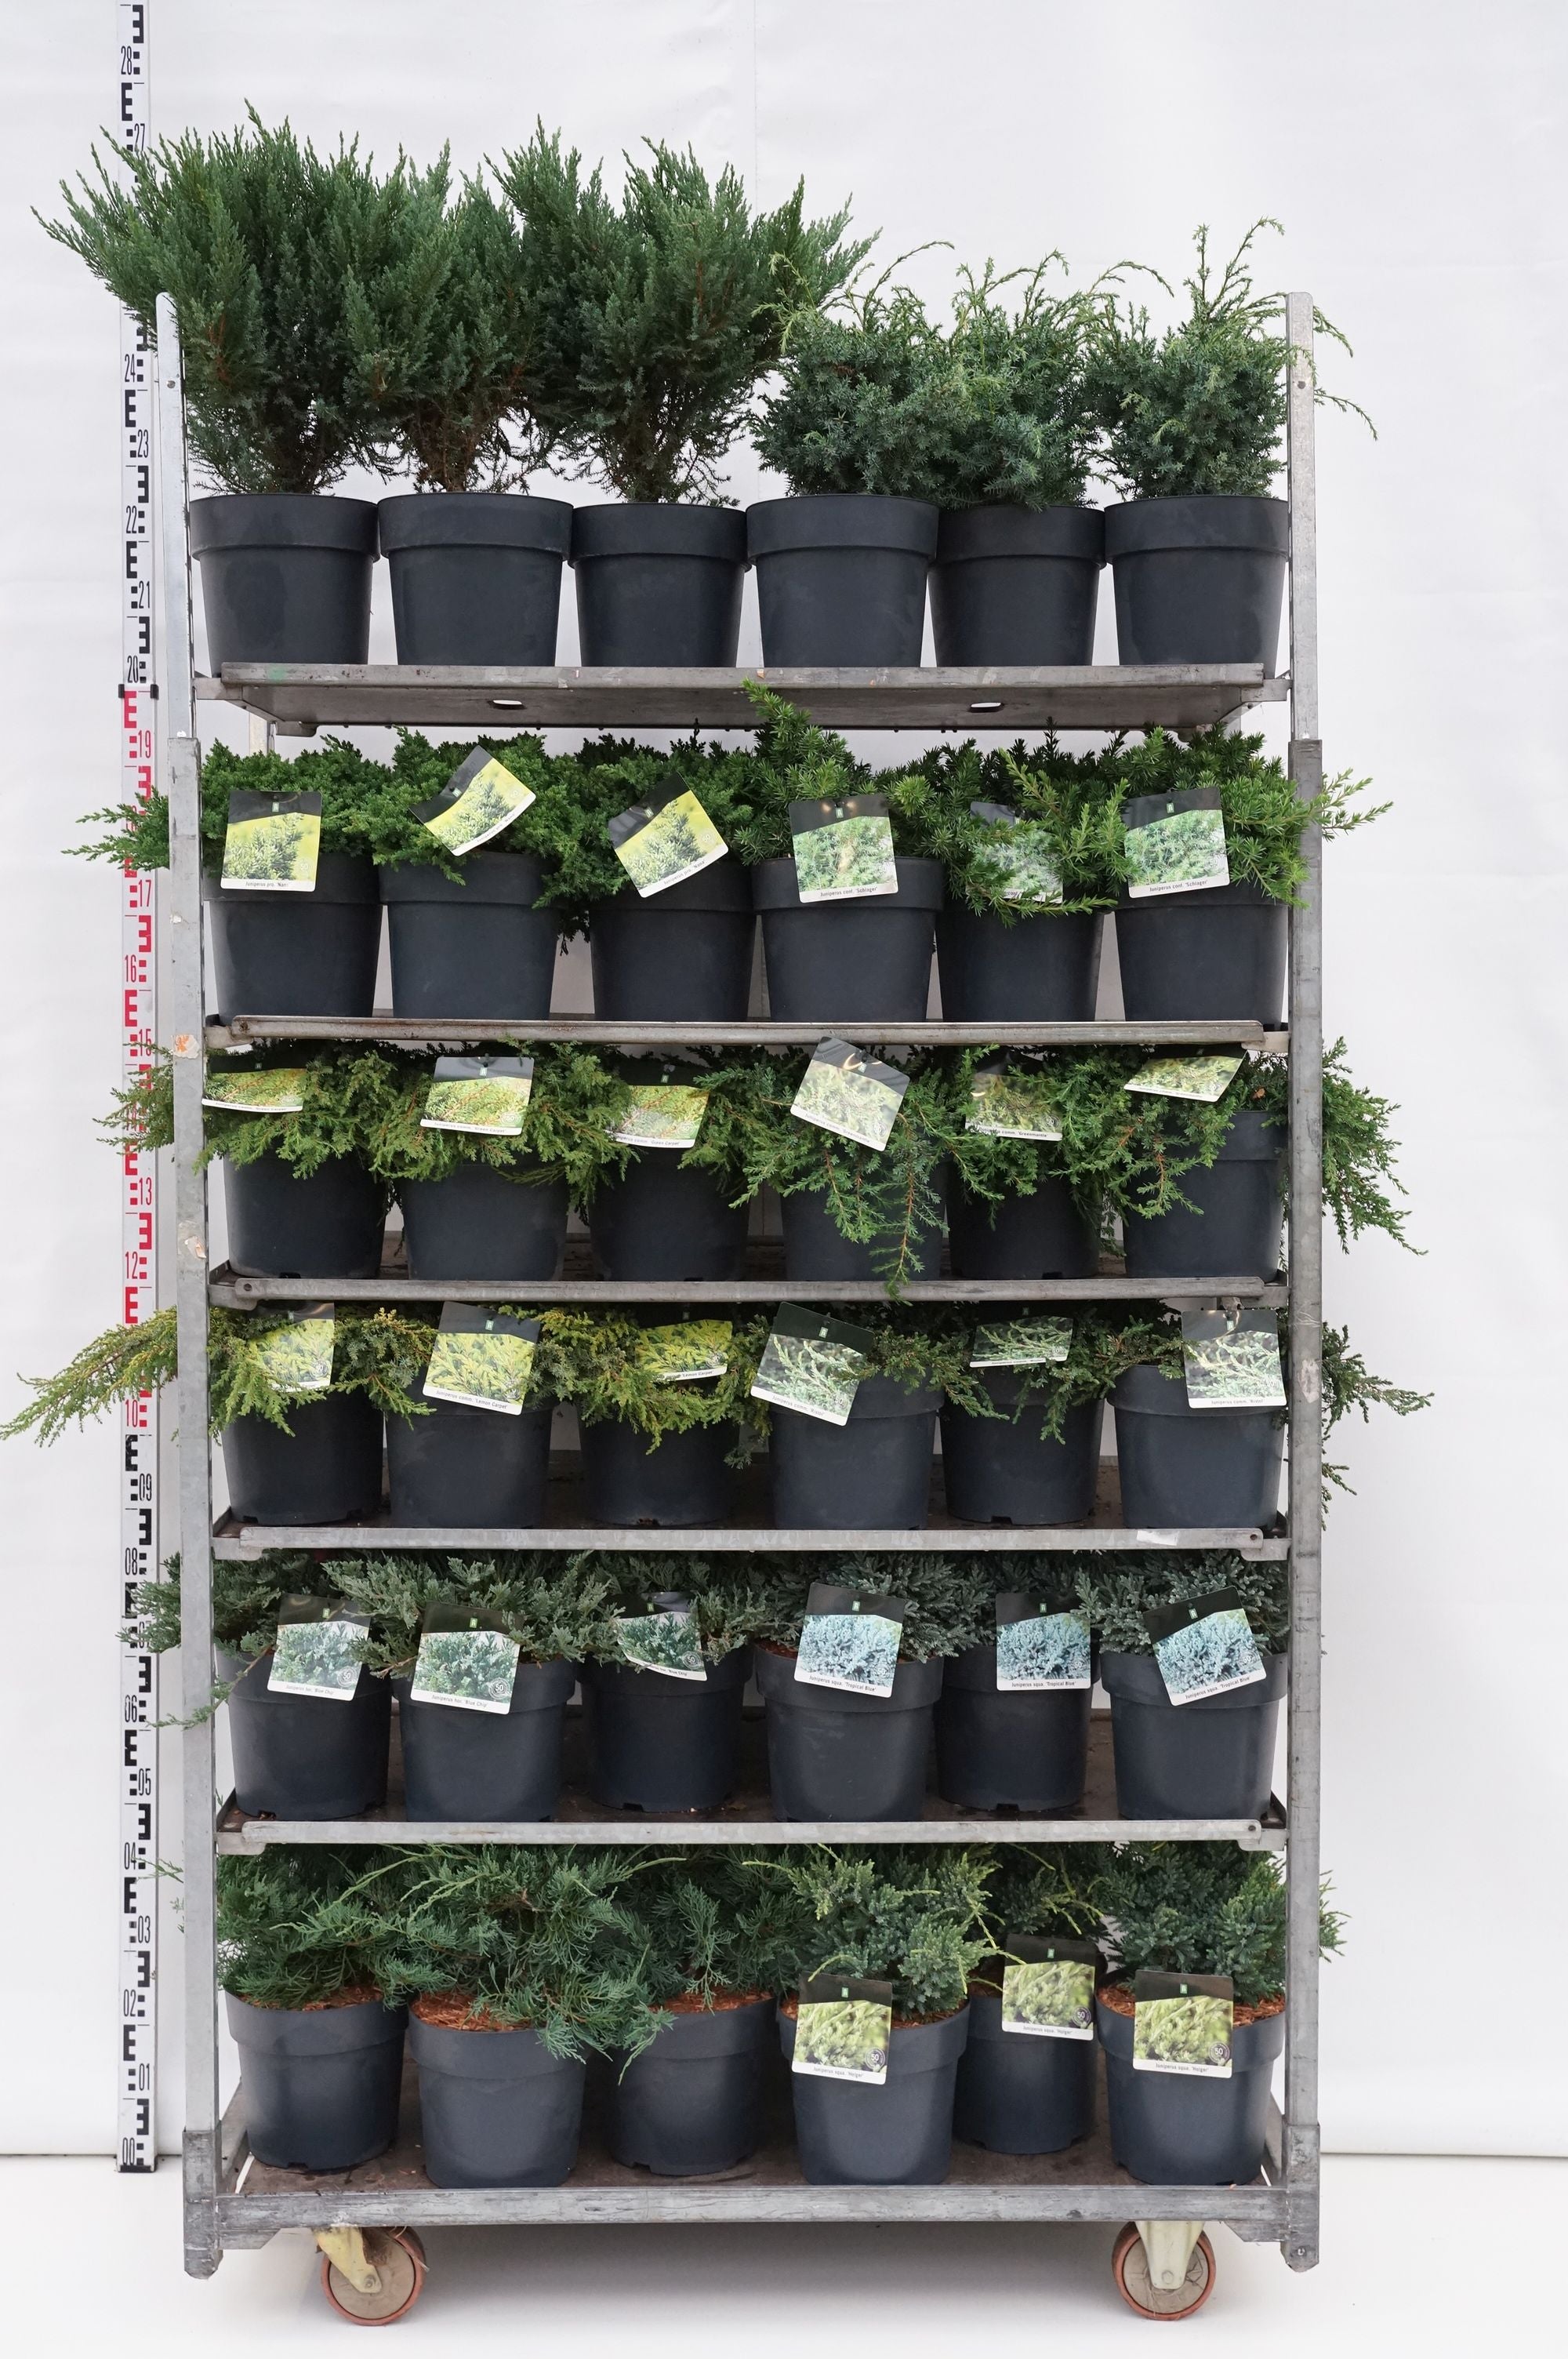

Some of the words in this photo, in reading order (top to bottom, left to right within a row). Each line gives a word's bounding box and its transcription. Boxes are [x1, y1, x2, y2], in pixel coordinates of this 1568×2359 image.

[121, 46, 132, 75] 28
[134, 124, 145, 151] 27
[125, 354, 136, 382] 24
[137, 430, 148, 458] 23
[126, 506, 137, 533] 22
[139, 581, 150, 609] 21
[127, 656, 138, 683] 20
[138, 730, 151, 758] 19
[139, 880, 151, 907] 17
[125, 955, 136, 983] 16
[139, 1029, 151, 1056] 15
[139, 1178, 152, 1205] 13
[125, 1251, 139, 1279] 12
[125, 1399, 139, 1427] 10
[139, 1474, 151, 1500] 09
[125, 1547, 137, 1576] 08
[809, 1675, 830, 1684] Juniperus
[125, 1695, 137, 1722] 06
[1185, 1690, 1207, 1699] Juniperus
[139, 1768, 151, 1796] 05
[125, 1843, 136, 1870] 04
[138, 1915, 151, 1943] 03
[123, 1989, 136, 2016] 02
[139, 2063, 150, 2091] 01
[123, 2137, 135, 2165] 00
